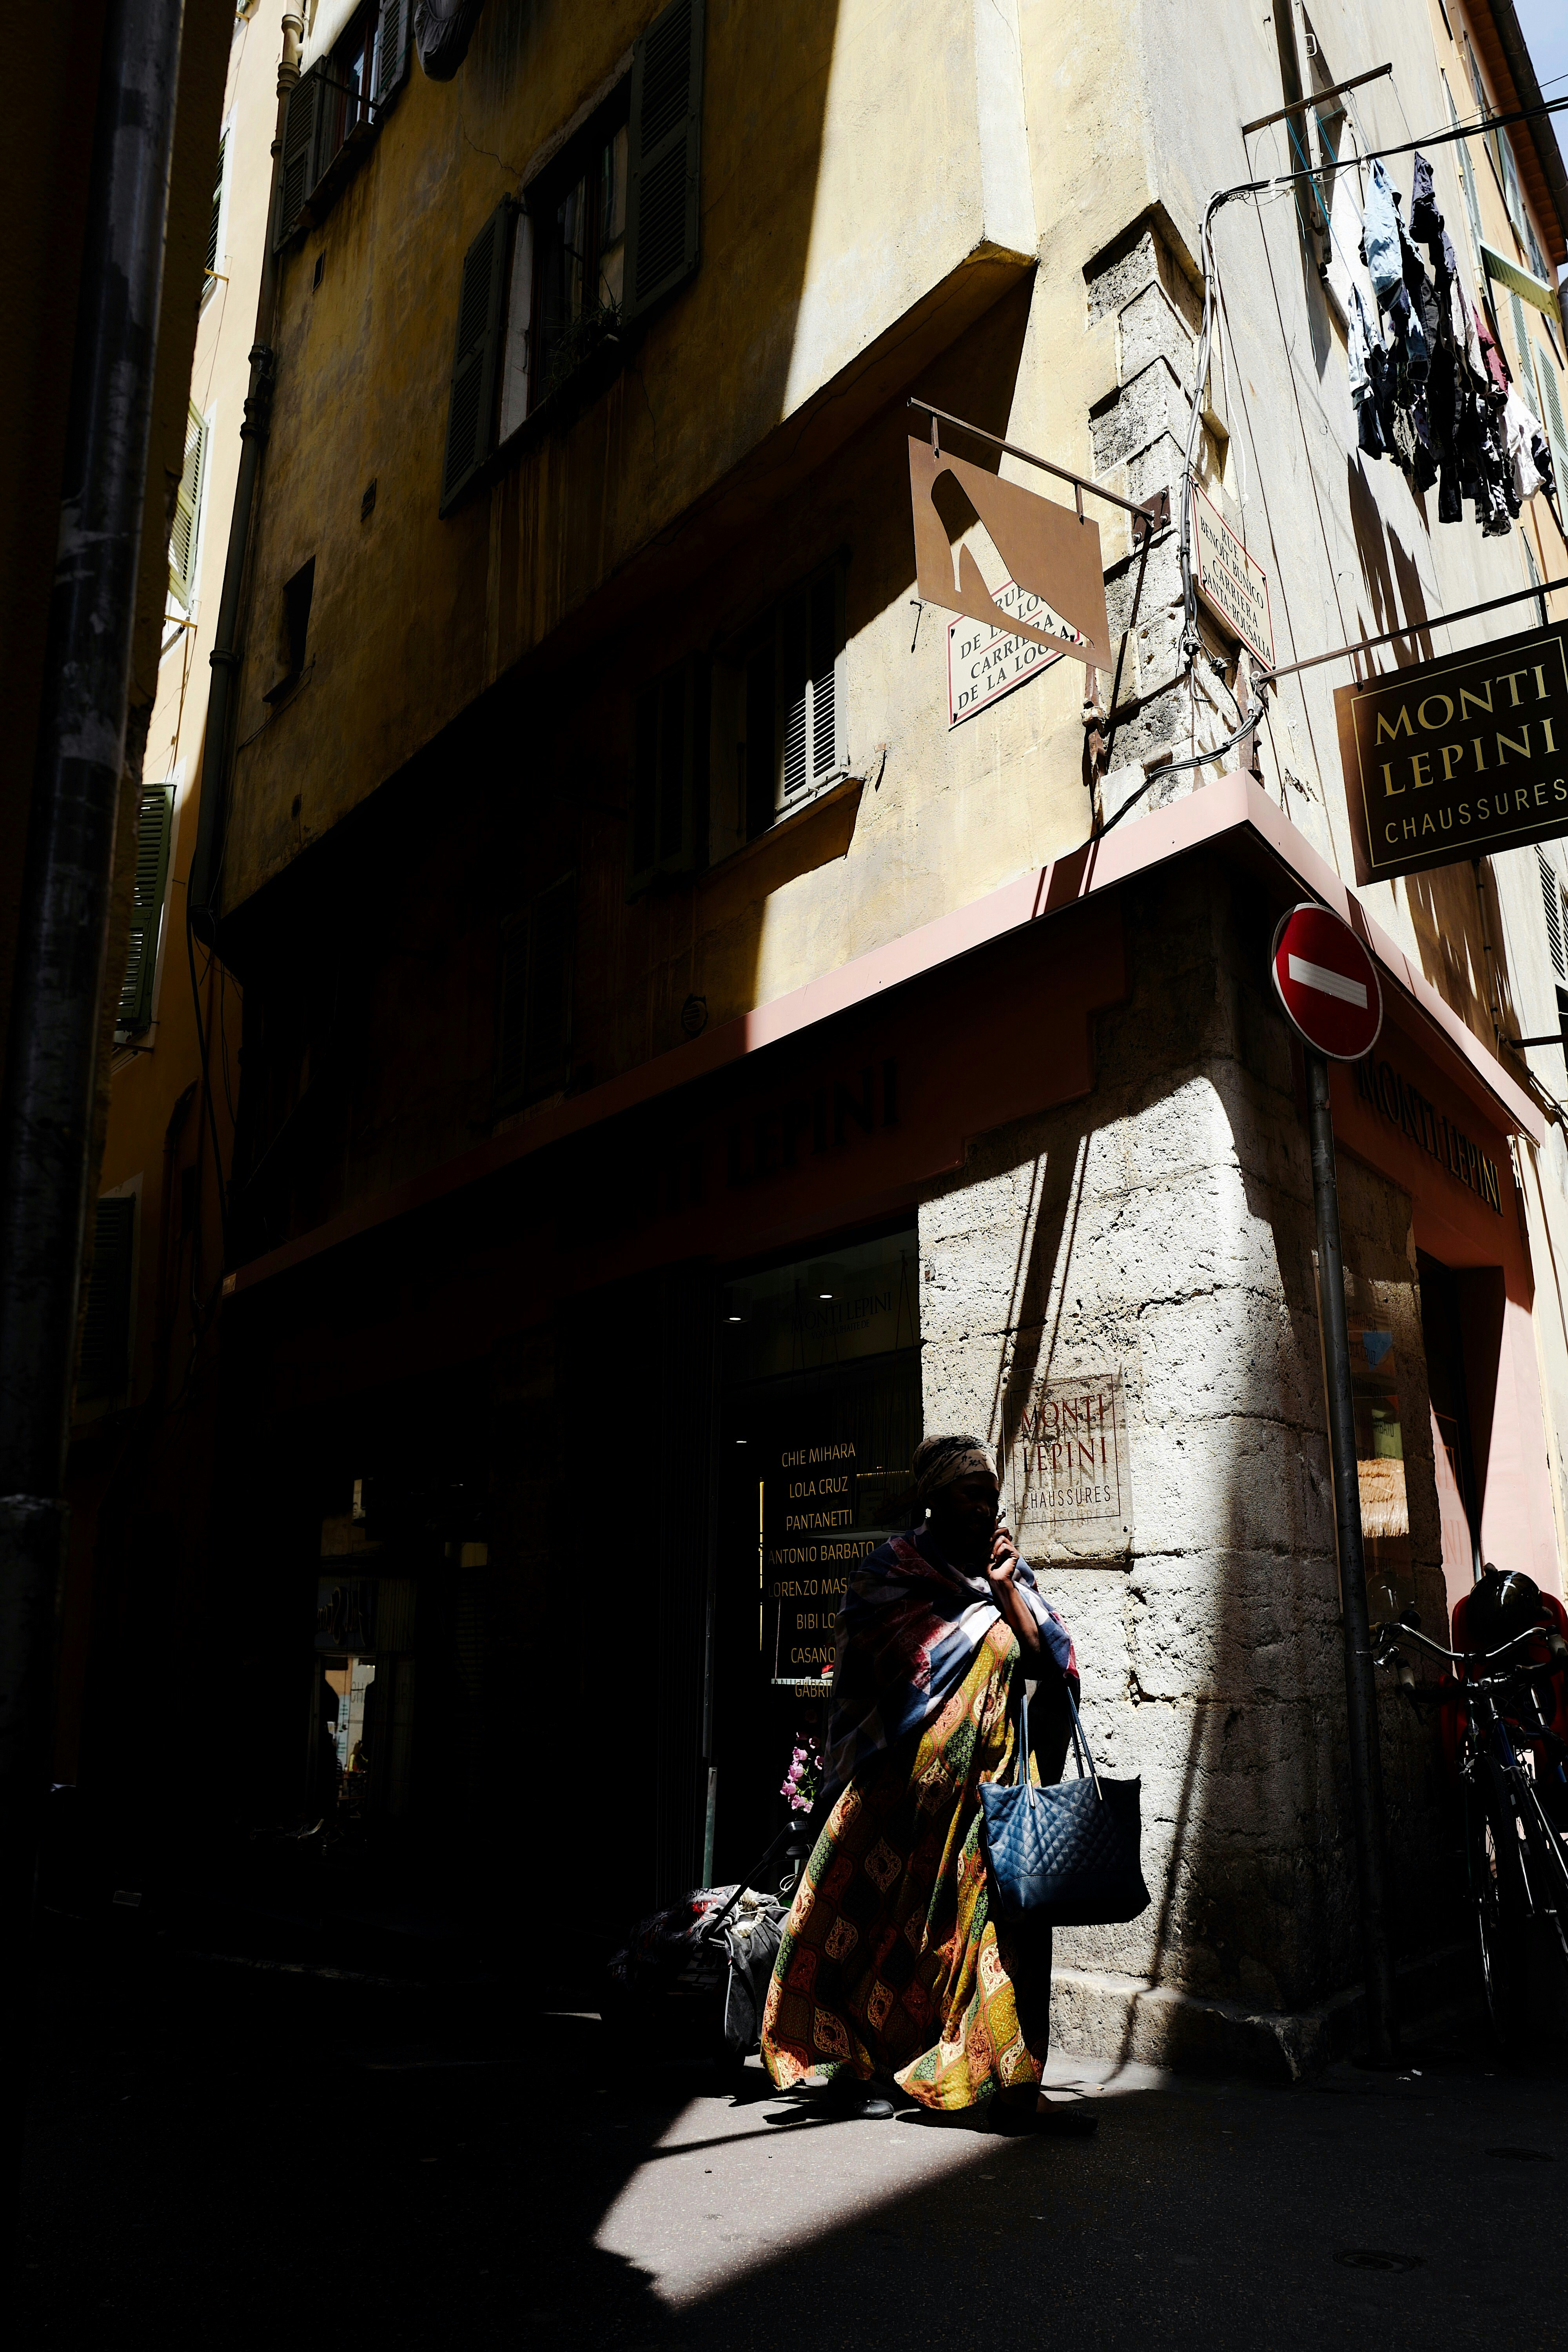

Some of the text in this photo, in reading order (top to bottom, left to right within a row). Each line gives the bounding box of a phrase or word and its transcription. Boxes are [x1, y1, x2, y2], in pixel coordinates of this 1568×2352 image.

[1221, 526, 1239, 561] RUE
[1200, 515, 1264, 609] BENOÎT BUNICO
[1212, 559, 1258, 628] CARRIERA
[961, 633, 981, 660] DE
[1018, 595, 1045, 620] LO
[958, 626, 1070, 710] DE LA LOGA
[1374, 664, 1551, 746] MONTI
[1379, 717, 1560, 797] LEPINI
[1385, 778, 1568, 844] CHAUSSURES
[723, 1054, 900, 1188] LEPINI
[1358, 1049, 1504, 1217] MONTI LEPINI
[790, 1291, 892, 1334] MONTI LEPINI
[811, 1319, 869, 1339] VOUS SOUHAITE DE
[1348, 1339, 1377, 1366] OLA CRUZ
[1020, 1394, 1106, 1433] MONTI
[781, 1442, 856, 1467] CHIE MIHARA
[1022, 1436, 1108, 1473] LEPINI
[789, 1476, 848, 1499] LOLA CRUZ
[1022, 1485, 1111, 1510] CHAUSSURES
[786, 1509, 853, 1531] PANTANETTI
[768, 1541, 874, 1566] ANTONIO BARBATO
[768, 1577, 848, 1598] LORENZO MAS
[796, 1612, 836, 1630] BIBI LO
[791, 1647, 837, 1664] CASANO
[795, 1681, 833, 1698] GABRI
